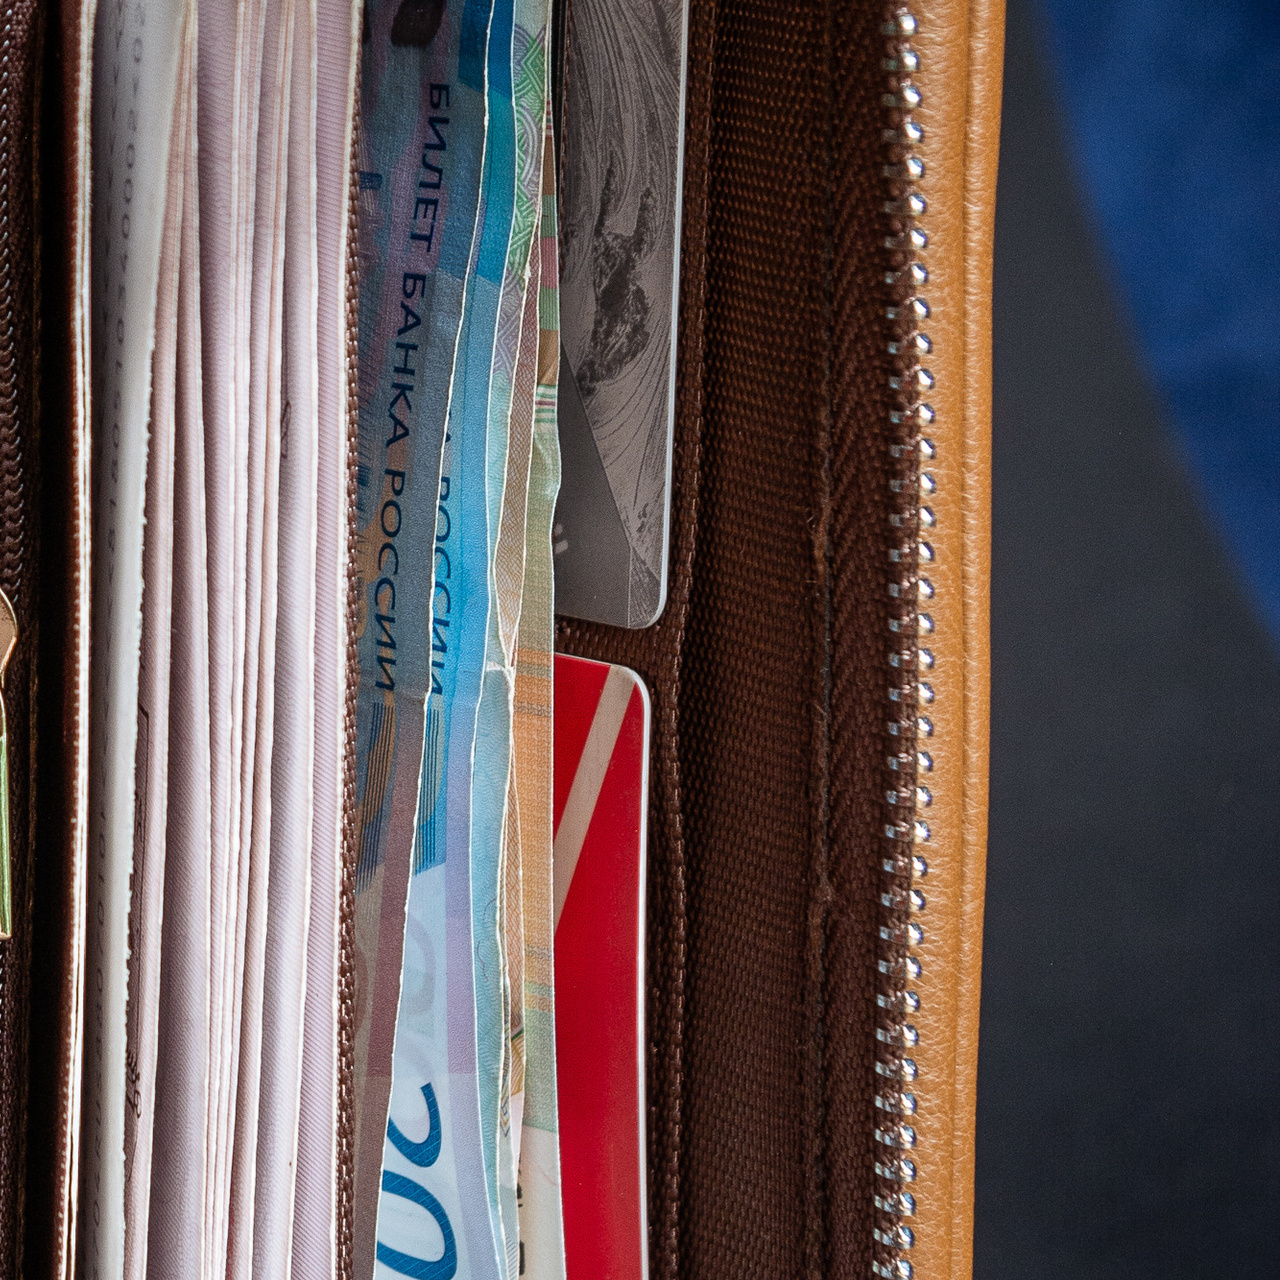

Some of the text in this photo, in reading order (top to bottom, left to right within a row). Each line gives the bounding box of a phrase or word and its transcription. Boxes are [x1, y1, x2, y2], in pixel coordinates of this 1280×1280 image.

[374, 82, 451, 691] БИЛЕТ БАНКА РОССИИ
